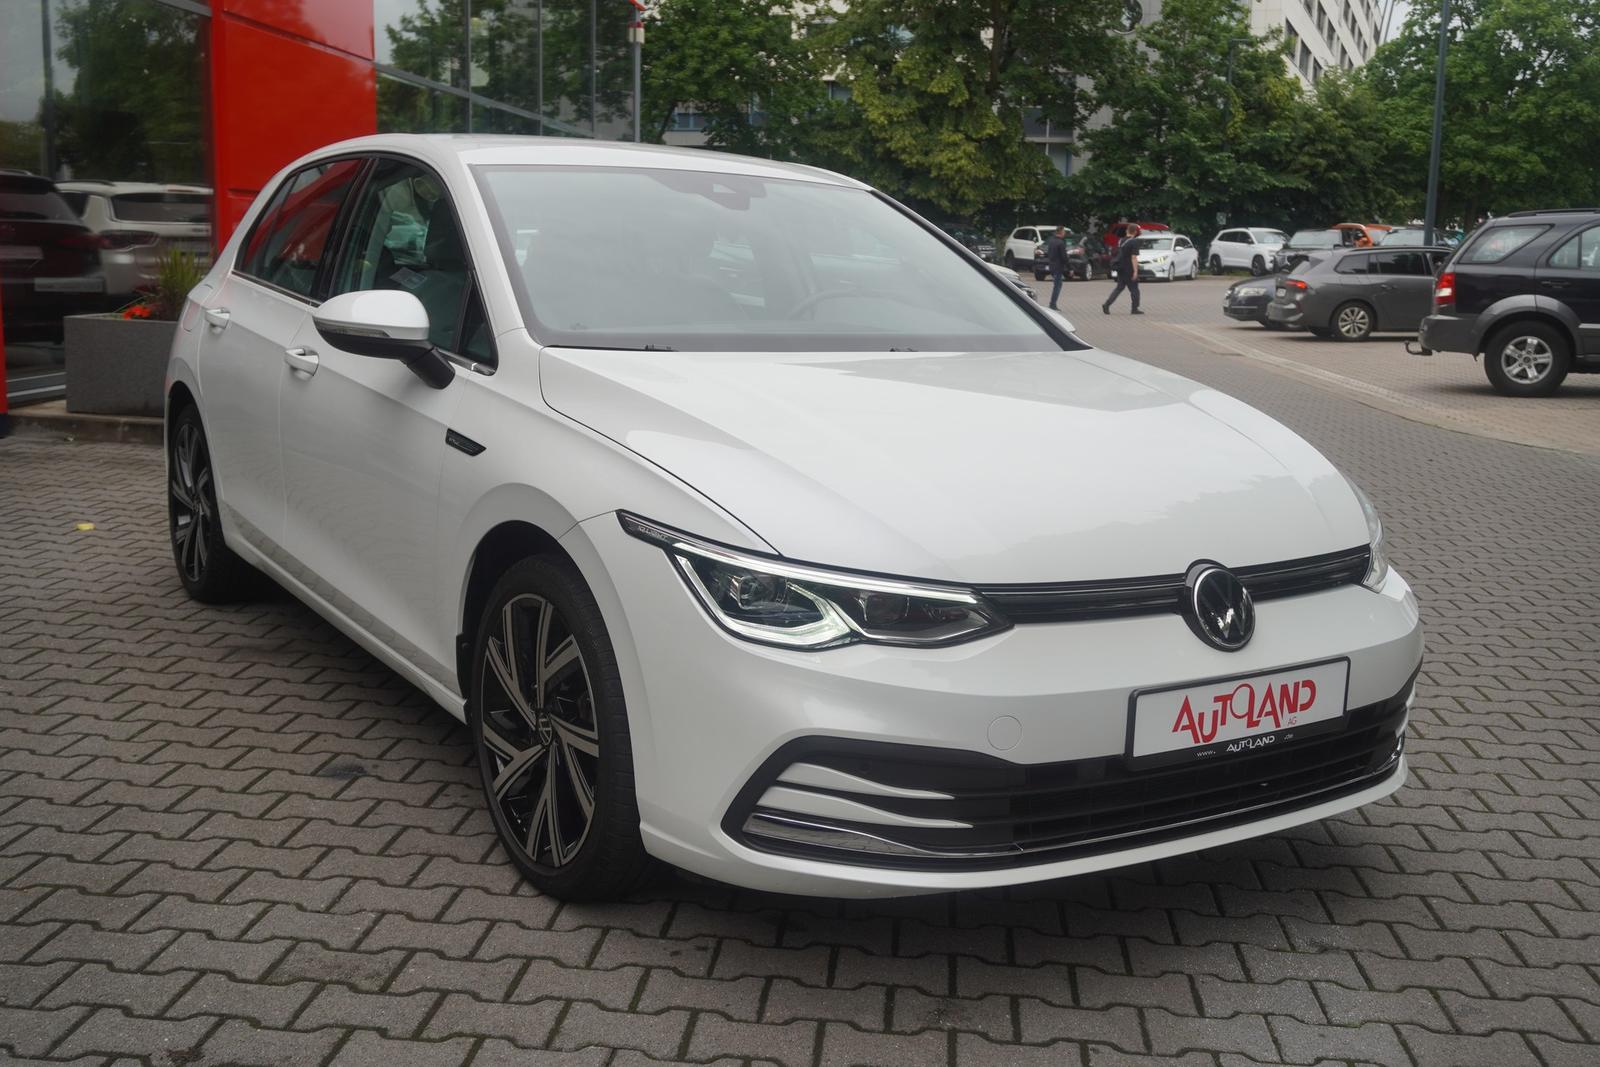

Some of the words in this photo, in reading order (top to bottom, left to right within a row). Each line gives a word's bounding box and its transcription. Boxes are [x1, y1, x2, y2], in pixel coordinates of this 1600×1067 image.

[1172, 679, 1317, 744] AUTOLAND
[1287, 716, 1298, 726] AG
[1226, 735, 1275, 752] AUTOLAND
